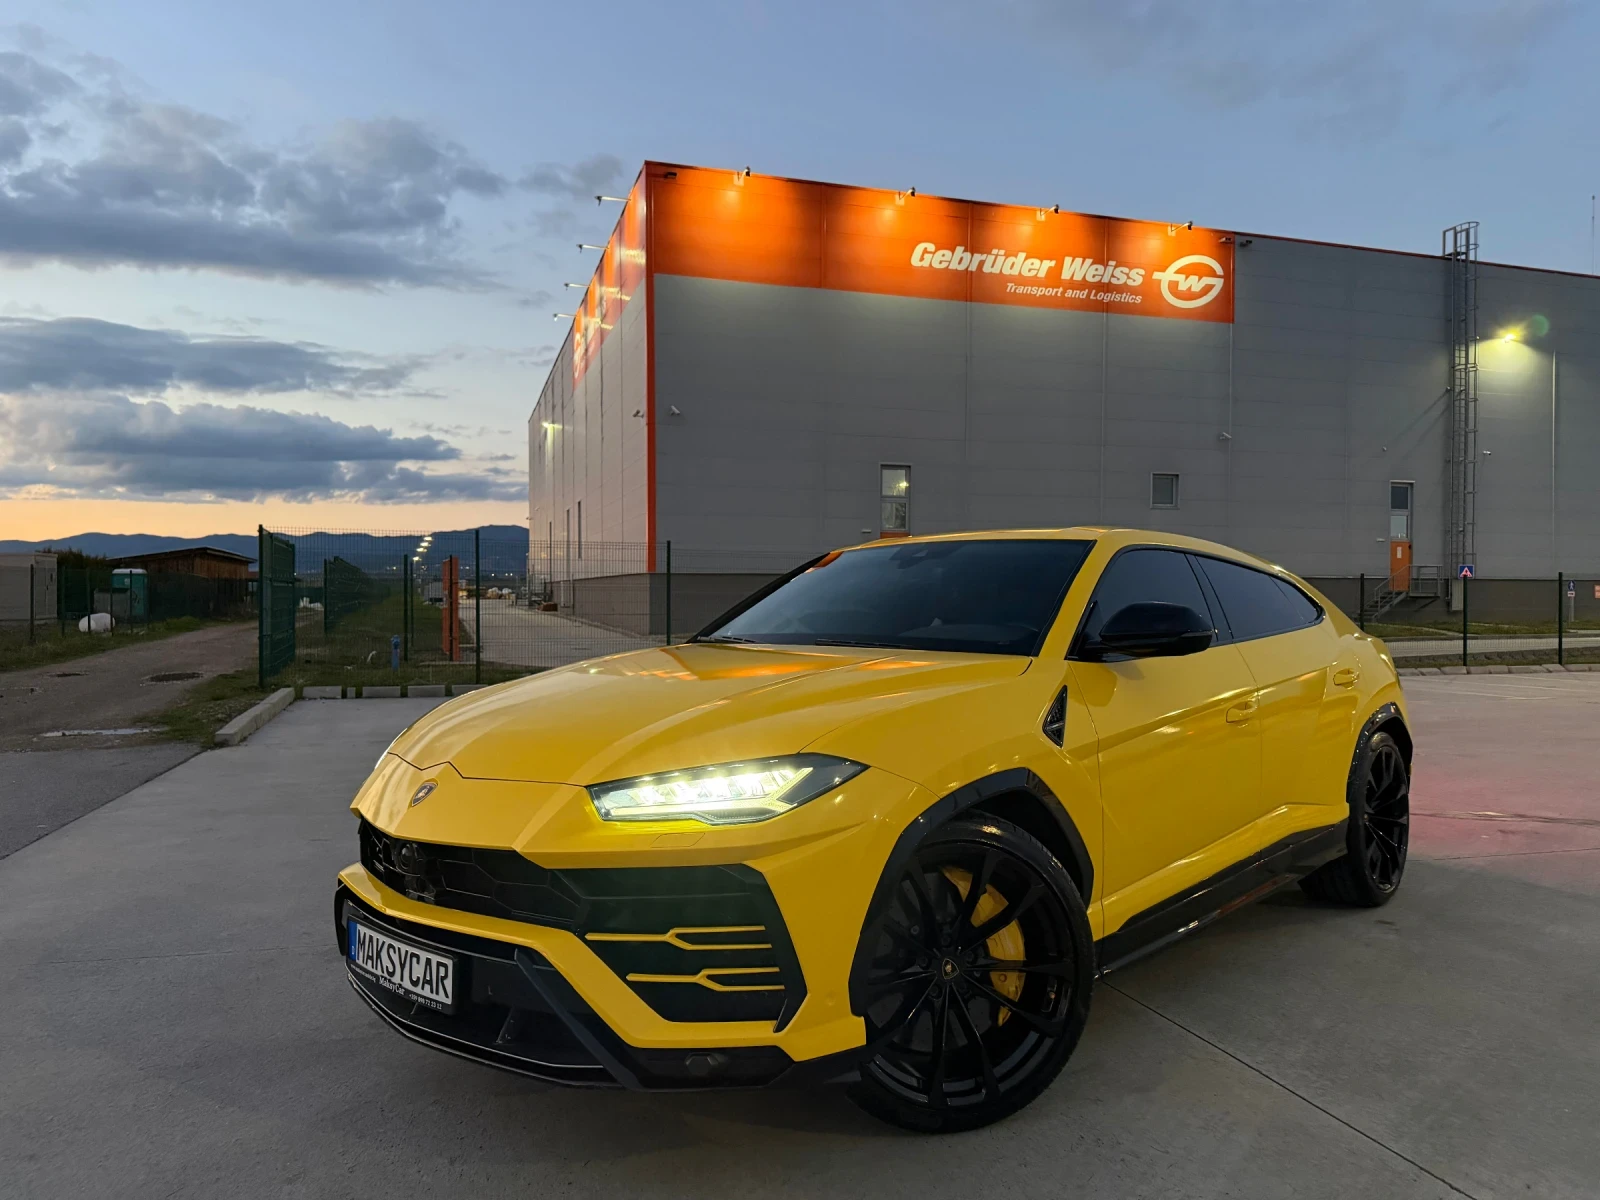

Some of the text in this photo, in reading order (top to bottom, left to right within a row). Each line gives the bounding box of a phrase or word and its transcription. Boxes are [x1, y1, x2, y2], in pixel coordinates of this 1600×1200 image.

[910, 242, 1145, 286] Gebrüder Weiss
[1006, 282, 1142, 304] Transport and Logistics
[357, 929, 450, 999] MAKSYCAR
